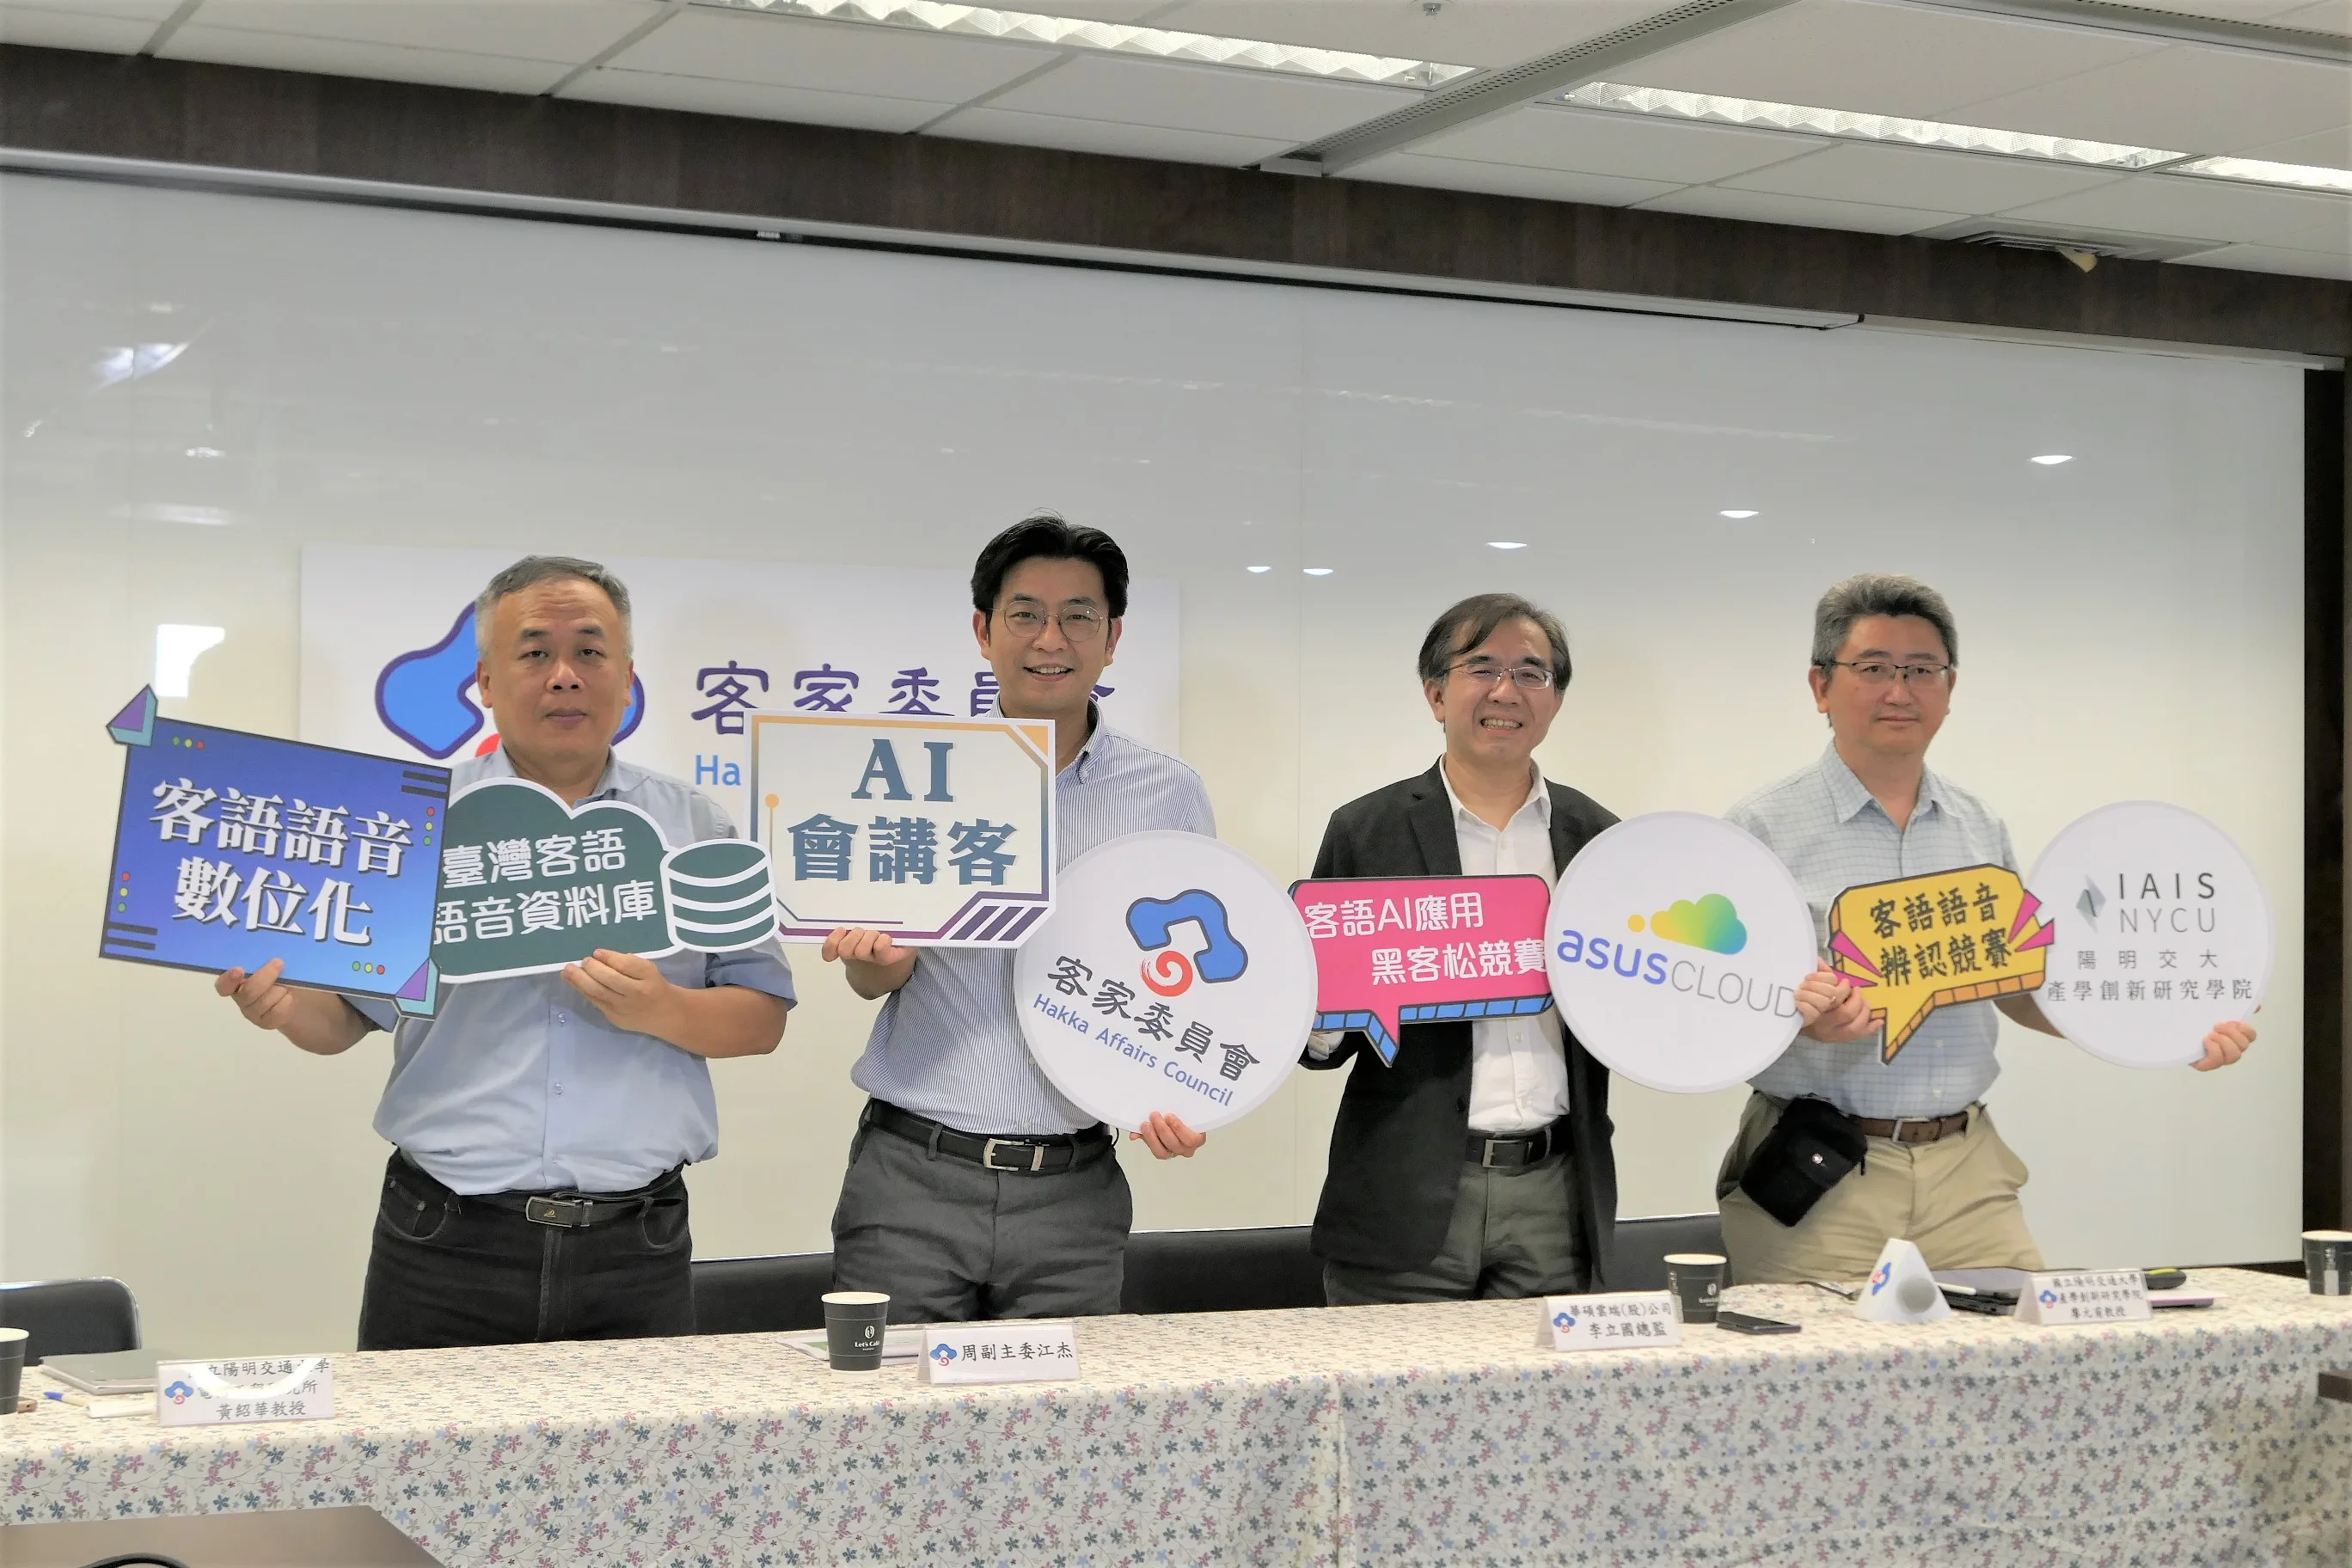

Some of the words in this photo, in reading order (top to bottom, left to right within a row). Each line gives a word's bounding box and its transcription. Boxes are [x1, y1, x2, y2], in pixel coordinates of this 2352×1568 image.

[850, 738, 955, 802] AI
[150, 777, 413, 877] 客語語音
[787, 813, 1016, 886] 會講客
[442, 827, 627, 889] 臺灣客語
[174, 855, 373, 945] 數位化
[433, 879, 658, 945] 語音資料庫
[1869, 882, 2000, 940] 客語語音
[2118, 872, 2215, 900] IAIS
[1304, 891, 1484, 940] 客語AI應用
[2120, 907, 2216, 934] NYCU
[1371, 937, 1547, 986] 黑客松競賽
[2077, 949, 2218, 971] 陽明交大
[2048, 979, 2253, 1002] 產學創新研究學院
[1047, 955, 1261, 1081] 客家委員會
[1032, 993, 1090, 1035] Hakka
[1095, 1027, 1158, 1069] Affairs
[1163, 1061, 1234, 1106] Council
[961, 1341, 1074, 1362] 周副主委江杰
[1589, 1321, 1668, 1338] 李立國總監
[216, 1400, 307, 1420] 黃紹華教授
